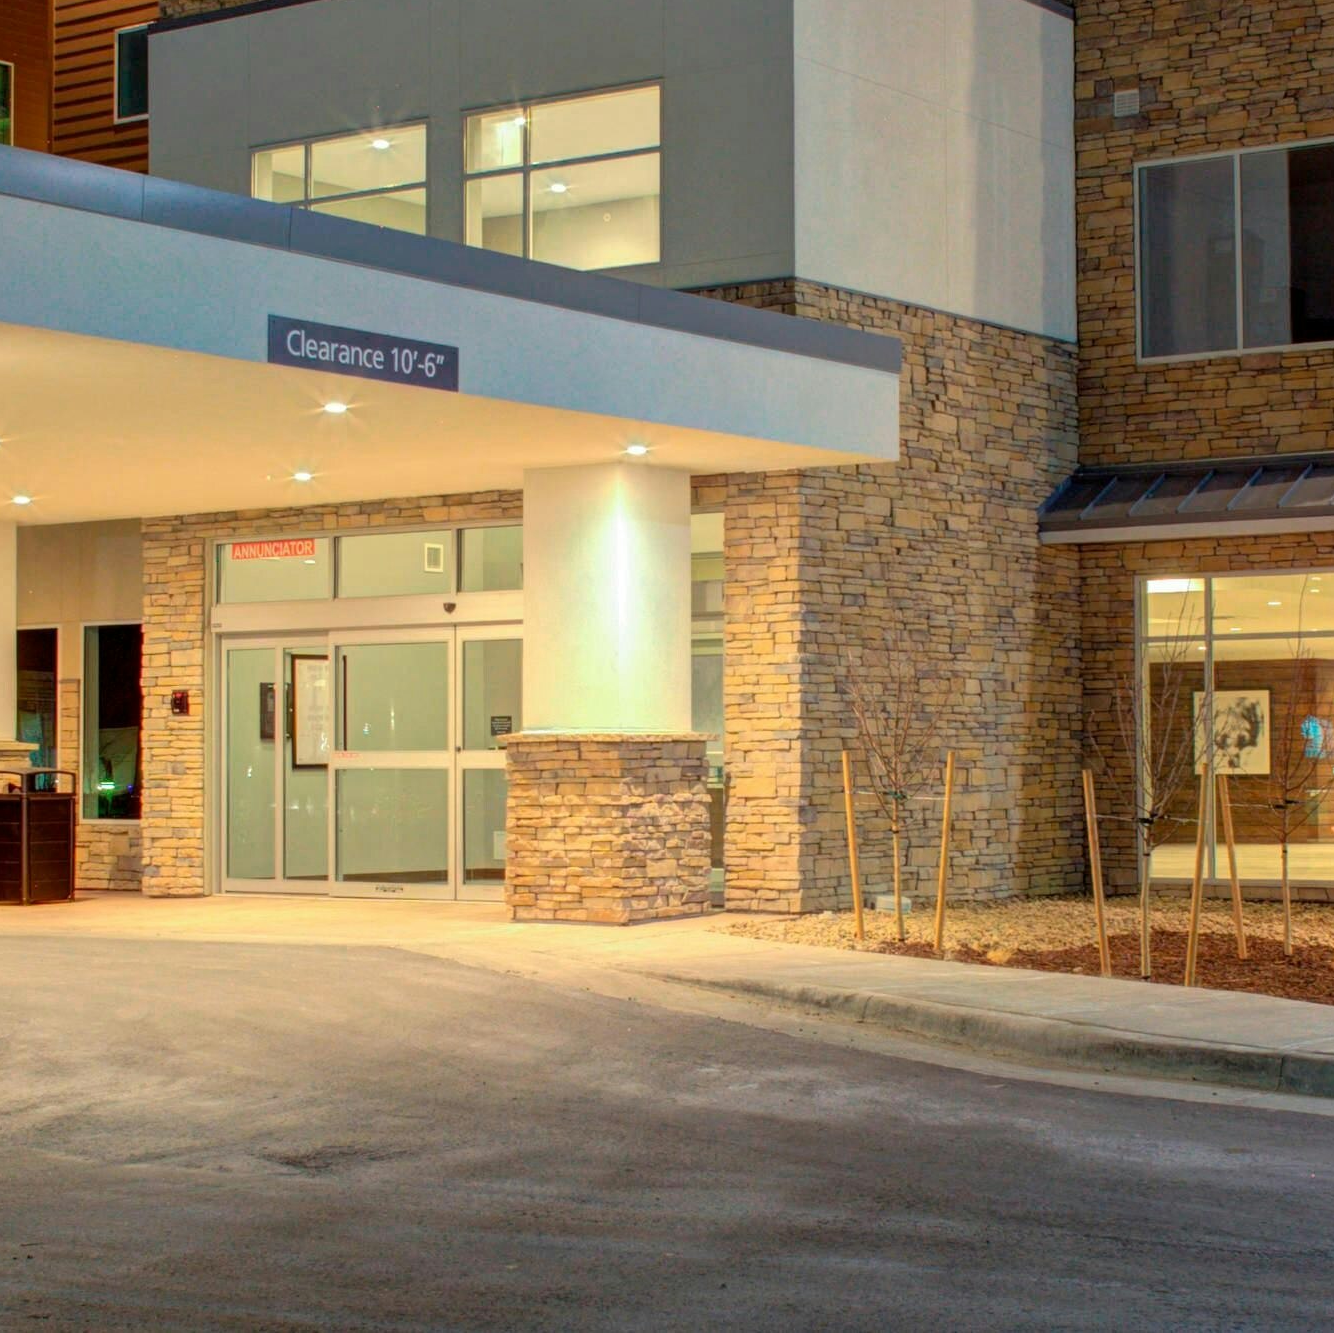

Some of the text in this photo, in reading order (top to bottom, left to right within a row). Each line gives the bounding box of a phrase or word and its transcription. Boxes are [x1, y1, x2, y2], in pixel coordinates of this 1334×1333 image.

[286, 329, 445, 378] Clearance 10'-6"
[233, 540, 313, 559] ANNUNCIATOR
